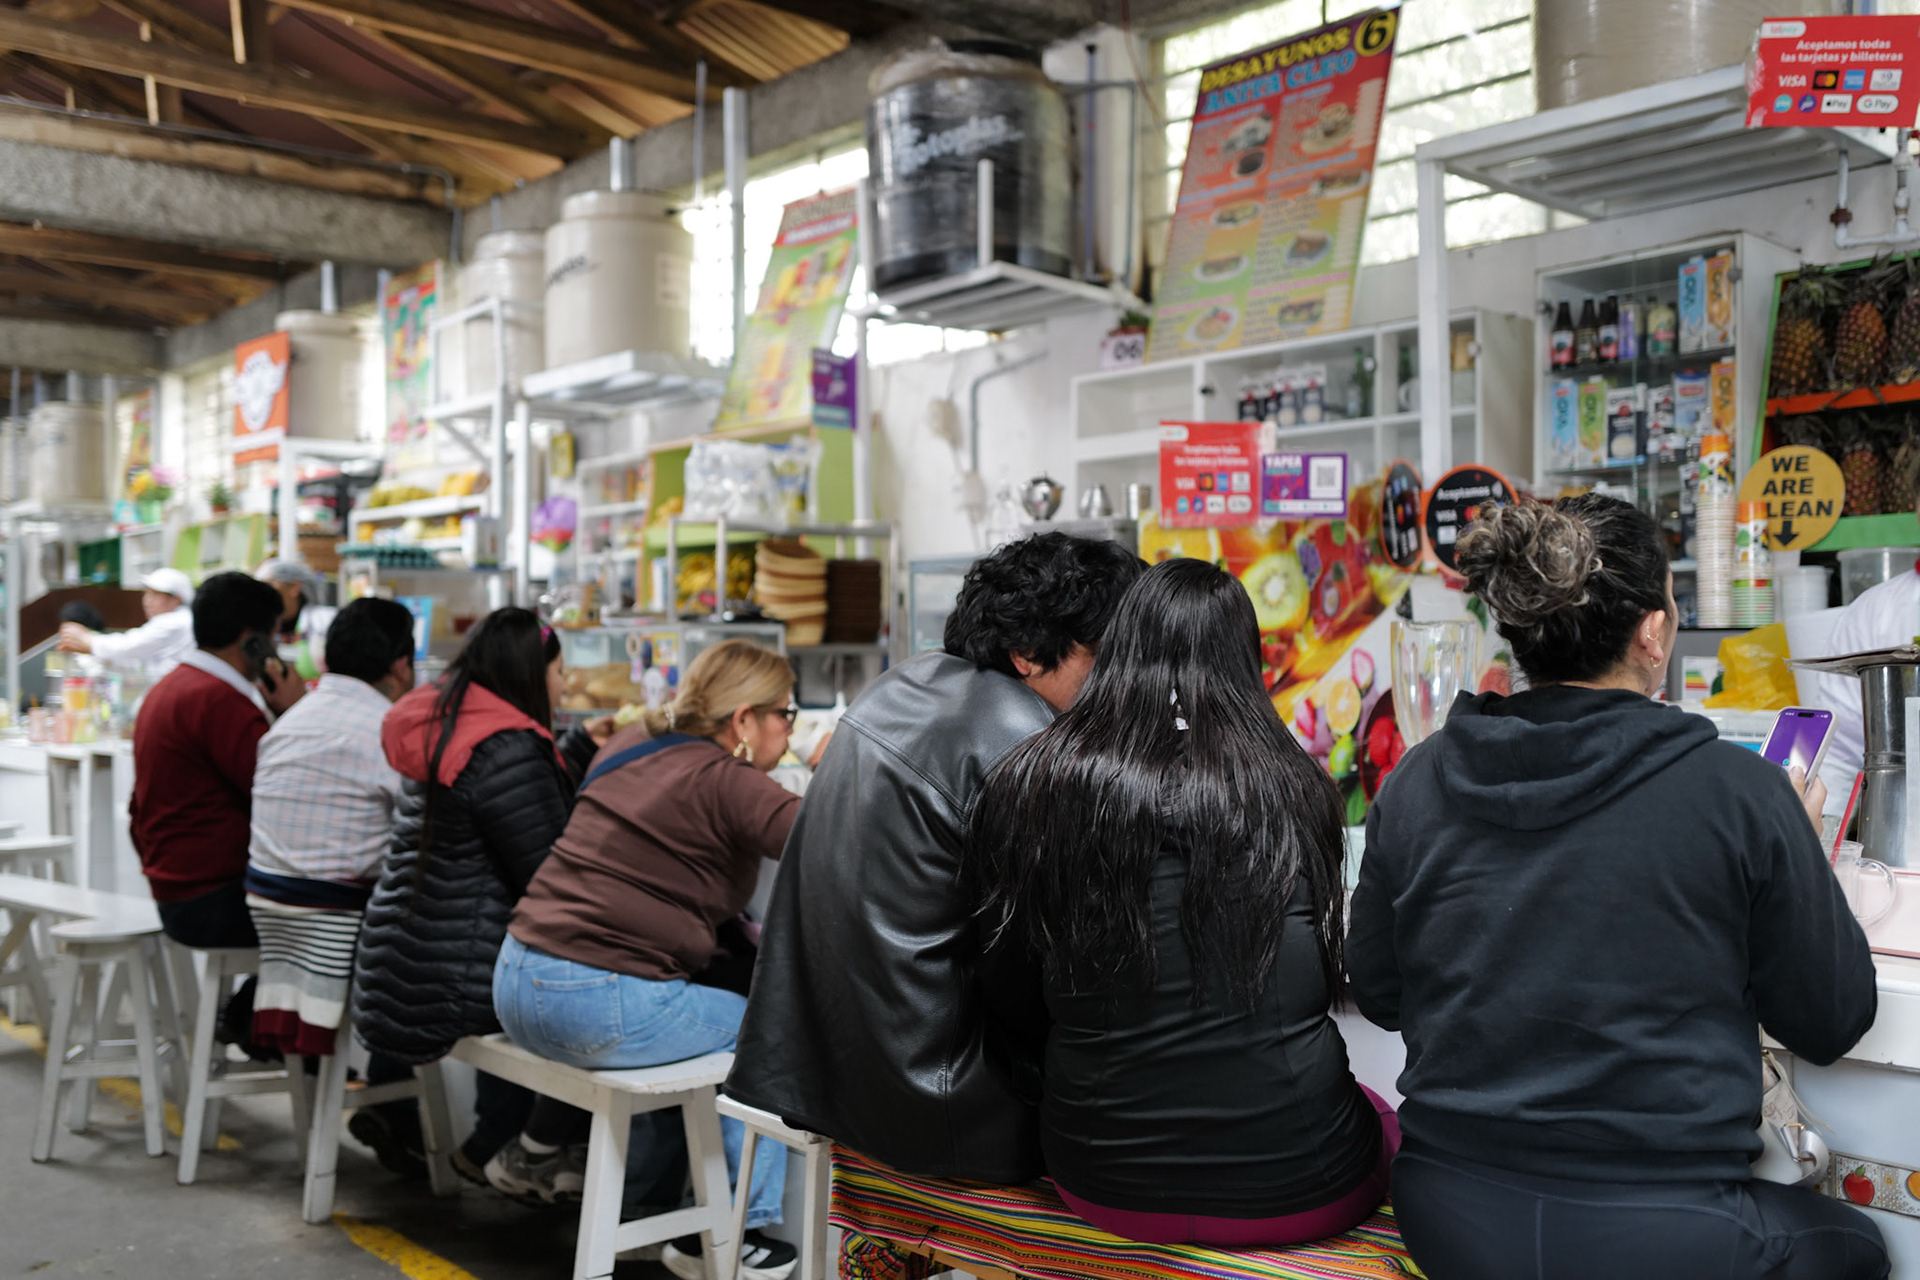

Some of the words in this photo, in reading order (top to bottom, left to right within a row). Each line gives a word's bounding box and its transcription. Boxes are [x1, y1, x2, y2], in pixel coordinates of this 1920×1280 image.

[1200, 27, 1351, 92] DESAYUNOS
[1362, 13, 1389, 51] 6
[1796, 40, 1858, 50] Aceptamos
[1859, 39, 1891, 49] todas
[1781, 52, 1797, 62] las
[1798, 52, 1839, 64] tarjetas
[1850, 51, 1904, 62] billeteras
[1286, 50, 1356, 88] CLEO
[1778, 75, 1807, 87] VISA
[1771, 454, 1810, 473] WE
[1762, 477, 1815, 496] ARE
[1767, 500, 1834, 518] LEAN
